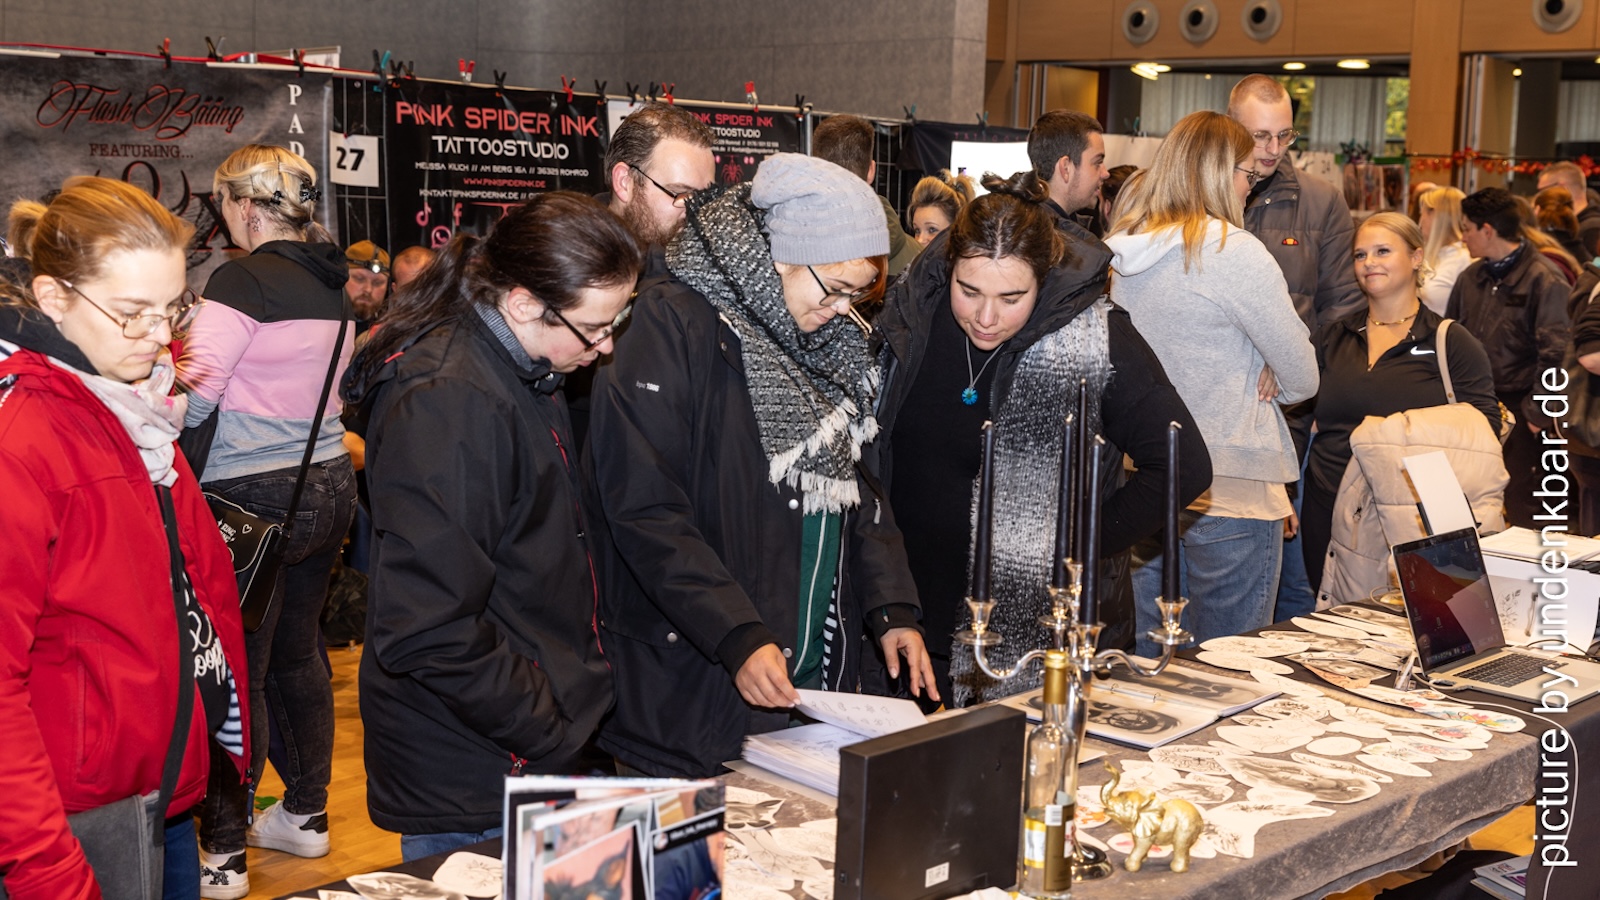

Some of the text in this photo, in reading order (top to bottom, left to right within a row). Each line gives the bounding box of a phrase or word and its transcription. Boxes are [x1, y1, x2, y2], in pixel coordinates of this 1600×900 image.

[36, 80, 133, 133] Flash
[396, 101, 599, 137] PINK SPIDER INK
[715, 113, 753, 126] SPIDER
[756, 116, 773, 127] INK
[89, 143, 194, 158] FEATURING...
[336, 146, 365, 171] 27
[431, 135, 569, 160] TATTOOSTUDIO
[480, 165, 491, 173] AM
[492, 165, 512, 174] BERG
